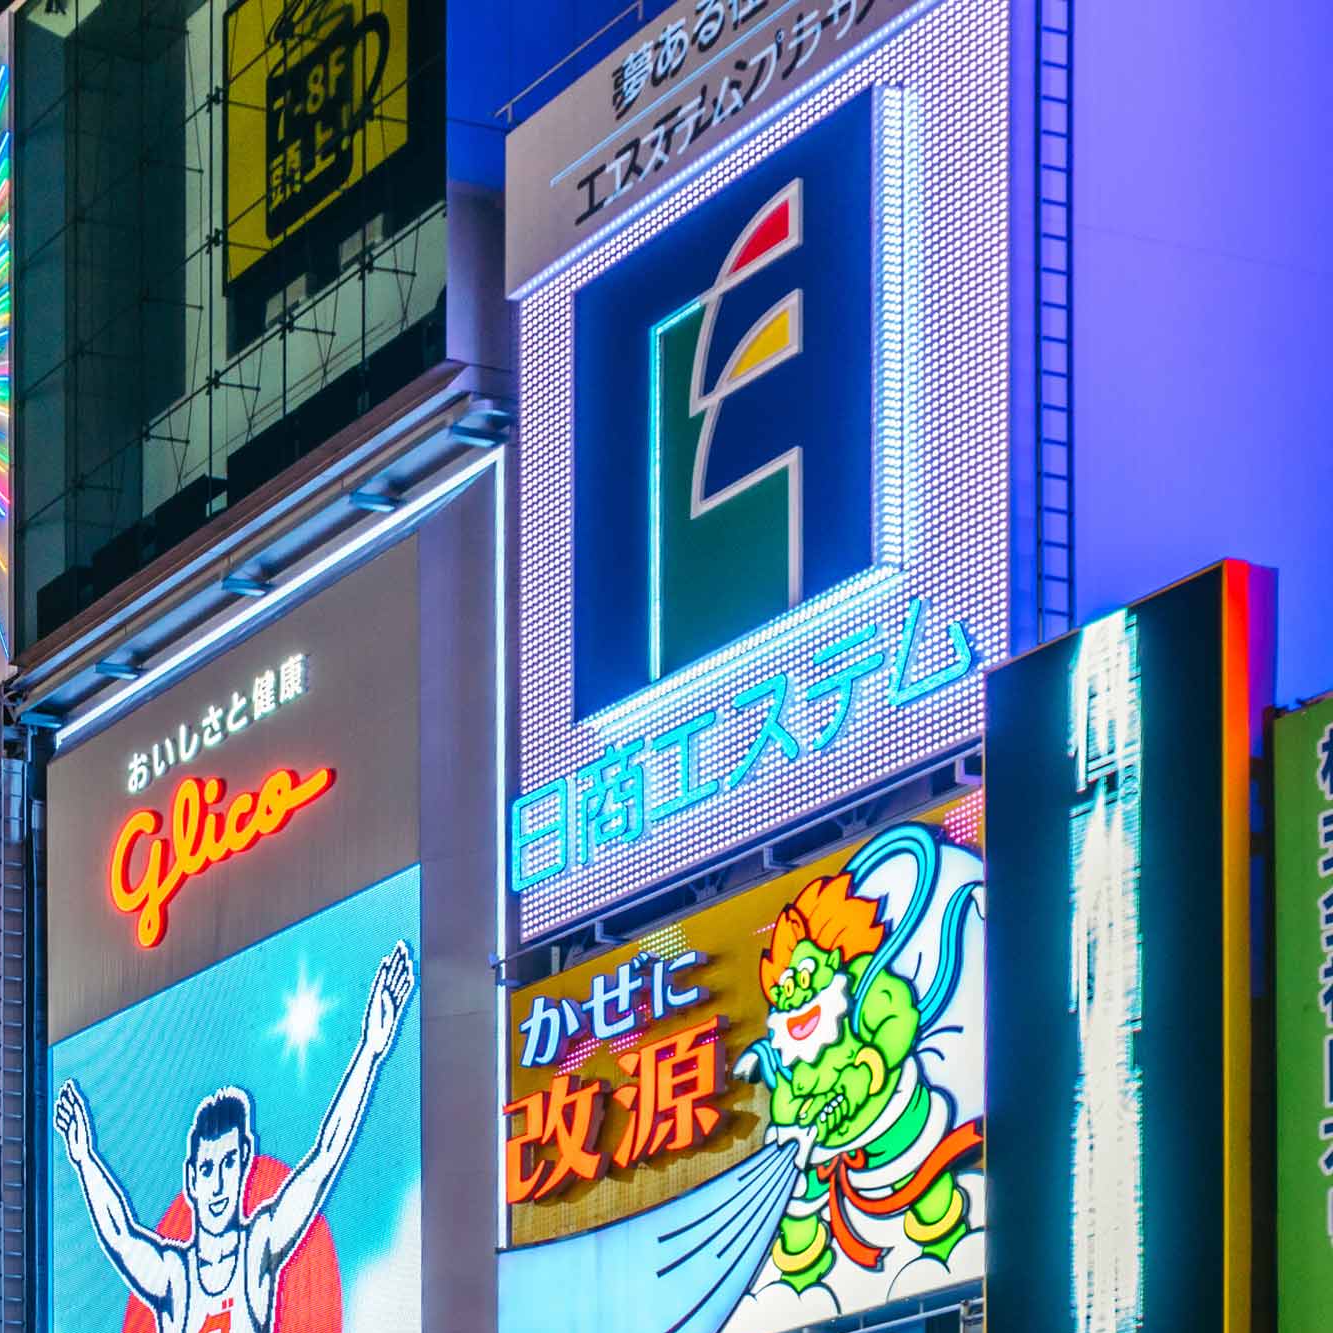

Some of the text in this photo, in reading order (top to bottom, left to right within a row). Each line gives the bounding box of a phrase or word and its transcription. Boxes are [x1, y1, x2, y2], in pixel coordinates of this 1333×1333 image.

[127, 653, 306, 794] おいしさと健康
[511, 598, 978, 892] 日商エステム
[108, 766, 337, 948] Glico
[520, 948, 706, 1069] かぜに
[503, 1014, 730, 1204] 改源
